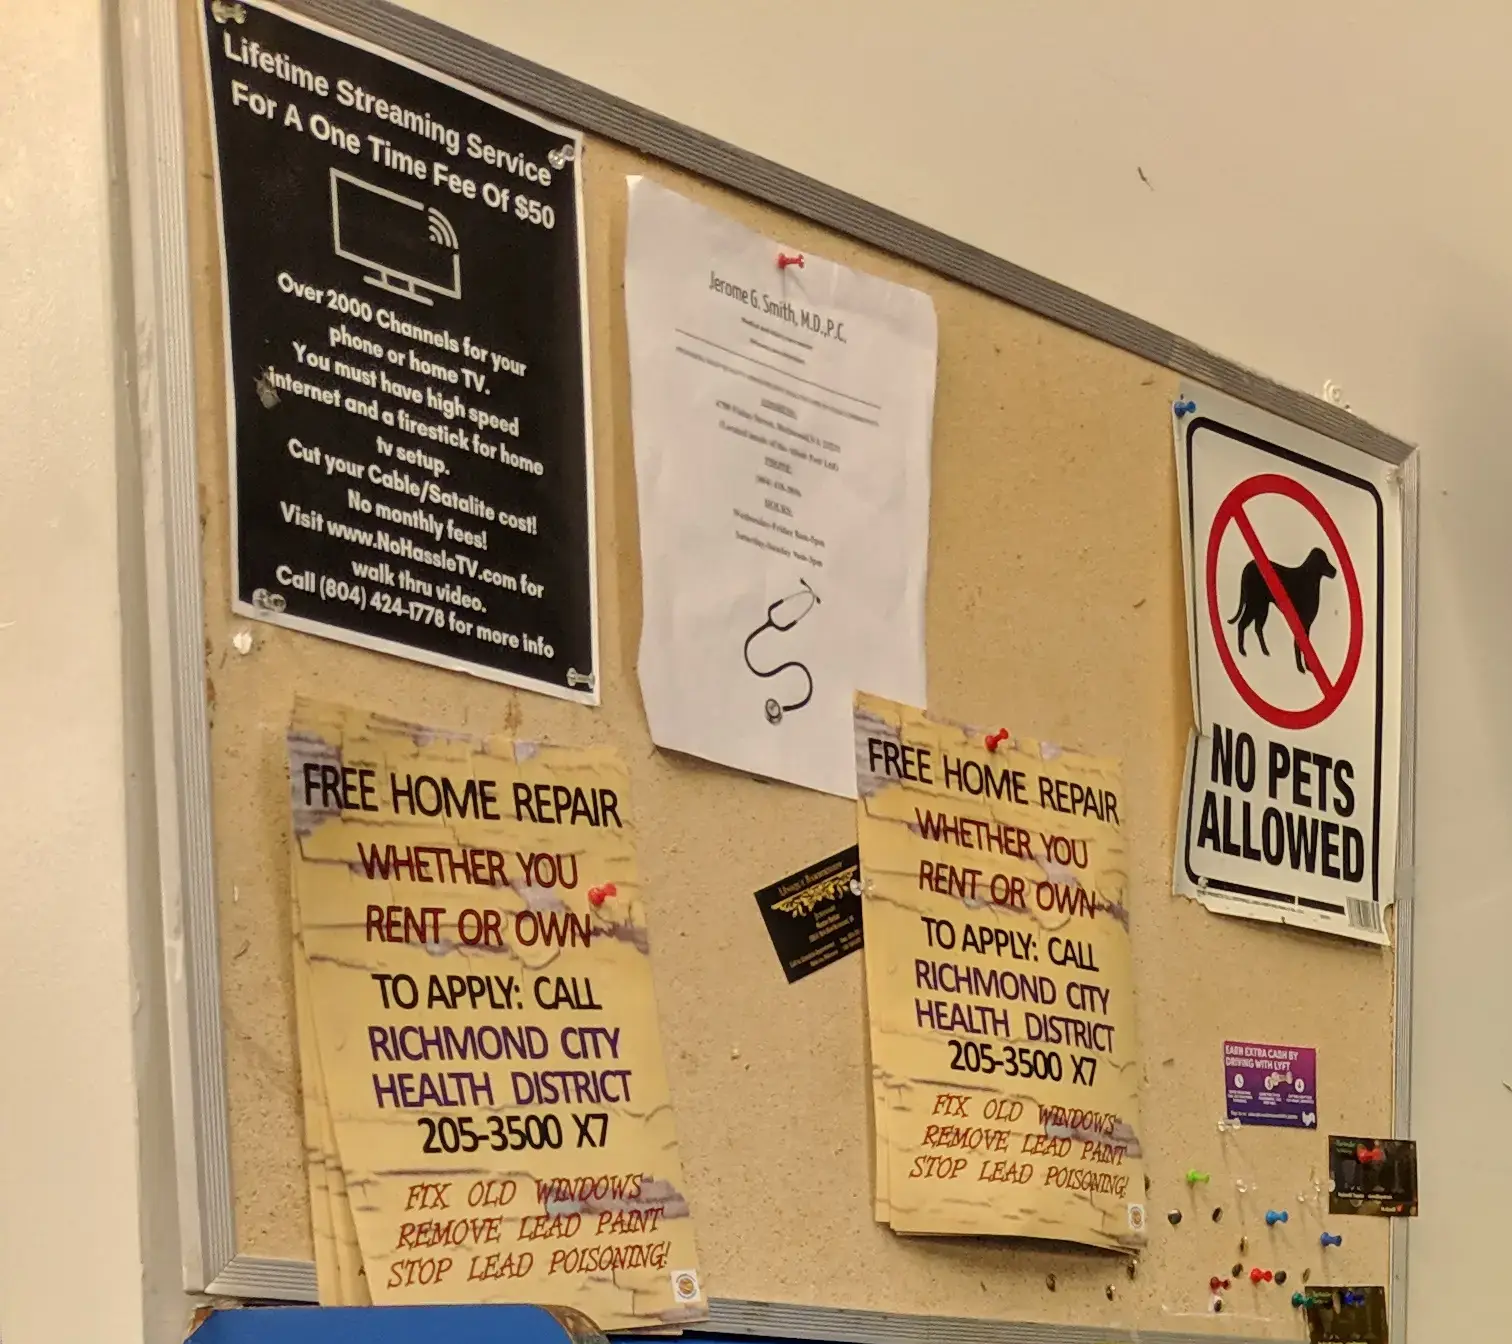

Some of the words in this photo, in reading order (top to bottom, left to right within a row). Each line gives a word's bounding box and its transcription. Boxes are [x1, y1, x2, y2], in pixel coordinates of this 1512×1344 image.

[223, 31, 329, 97] Lifetime
[337, 79, 460, 155] Streaming
[466, 133, 551, 187] Service
[231, 80, 277, 120] For
[284, 104, 303, 131] A
[310, 115, 360, 155] One
[368, 135, 427, 180] Time
[433, 163, 476, 199] Fee
[482, 184, 510, 212] Of
[514, 194, 555, 229] $50
[277, 272, 324, 303] Over
[326, 290, 372, 322] 2000
[376, 308, 459, 353] Channels
[463, 336, 487, 362] for
[491, 352, 527, 376] your
[709, 271, 748, 304] Jerome
[751, 289, 760, 309] G.
[763, 295, 799, 326] Smith,
[292, 340, 330, 371] You
[335, 361, 377, 388] must
[381, 371, 423, 404] have
[427, 388, 465, 419] high
[469, 406, 519, 437] speed
[329, 324, 383, 358] phone
[387, 349, 405, 366] or
[409, 350, 457, 383] home
[461, 368, 490, 395] TV.
[268, 366, 340, 407] internet
[345, 397, 378, 421] and
[382, 411, 394, 425] a
[397, 408, 469, 451] firestick
[472, 434, 497, 460] for
[500, 443, 543, 475] home
[288, 438, 321, 465] Cut
[325, 453, 365, 479] your
[368, 464, 494, 520] Cable/Satalite
[499, 512, 537, 535] cost!
[376, 436, 392, 456] tv
[396, 445, 450, 477] setup.
[280, 501, 323, 531] Visit
[326, 520, 517, 591] www.NoHassleTV.com
[520, 574, 544, 598] for
[347, 489, 372, 513] No
[376, 503, 443, 541] monthly
[447, 519, 487, 550] fees!
[276, 565, 315, 592] Call
[320, 575, 367, 610] (804)
[370, 591, 445, 628] 424-1778
[448, 612, 473, 636] for
[477, 625, 519, 649] more
[523, 633, 554, 658] info
[352, 560, 395, 587] walk
[398, 569, 432, 597] thru
[435, 582, 486, 613] video.
[303, 762, 378, 812] FREE
[392, 774, 500, 821] HOME
[514, 782, 622, 828] REPAIR
[867, 738, 932, 784] FREE
[943, 755, 1028, 806] HOME
[1040, 779, 1120, 824] REPAIR
[1211, 722, 1256, 793] NO
[1268, 740, 1356, 819] PETS
[358, 842, 508, 886] WHETHER
[518, 853, 578, 888] YOU
[1197, 789, 1365, 883] ALLOWED
[365, 905, 446, 945] RENT
[458, 908, 504, 946] OR
[515, 912, 592, 948] OWN
[372, 973, 418, 1010] TO
[426, 974, 520, 1010] APPLY:
[533, 976, 602, 1010] CALL
[368, 1025, 548, 1061] RICHMOND
[560, 1027, 620, 1059] CITY
[1255, 1059, 1273, 1069] WITH
[1274, 1061, 1290, 1070] LYFT
[372, 1072, 492, 1108] HEALTH
[513, 1070, 632, 1104] DISTRICT
[417, 1115, 562, 1153] 205-3500
[576, 1114, 609, 1148] X7
